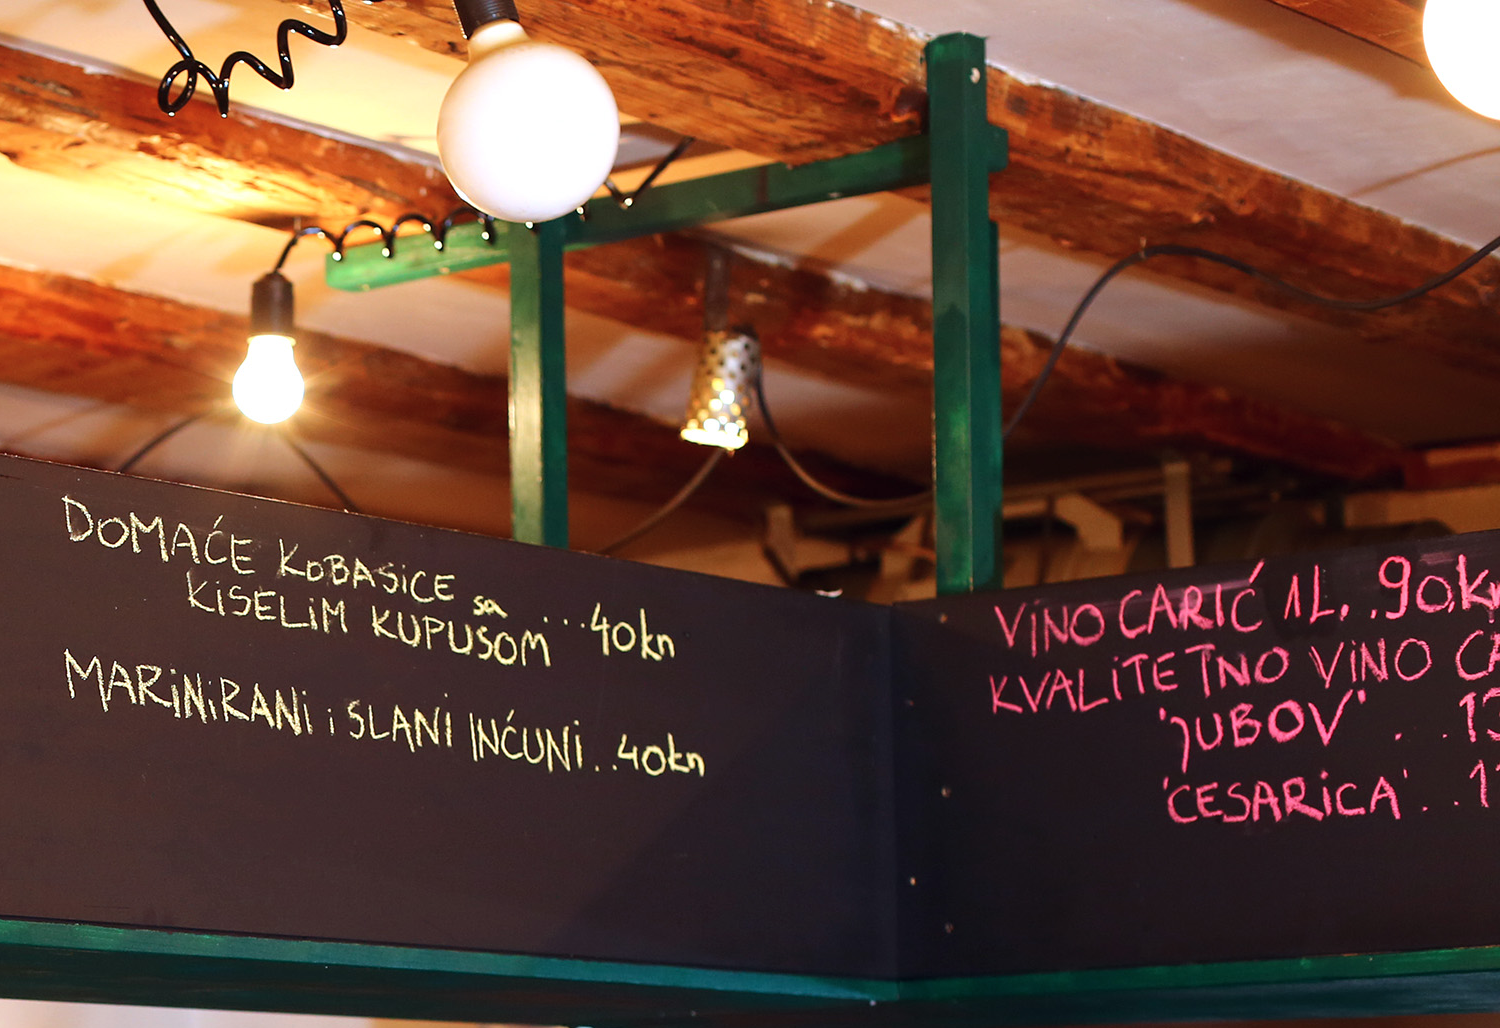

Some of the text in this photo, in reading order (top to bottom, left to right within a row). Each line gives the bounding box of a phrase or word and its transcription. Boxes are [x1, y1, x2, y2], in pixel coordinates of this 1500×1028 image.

[61, 494, 257, 576] DOMAĆE
[472, 595, 509, 619] sa
[371, 604, 553, 668] KUPUSOM
